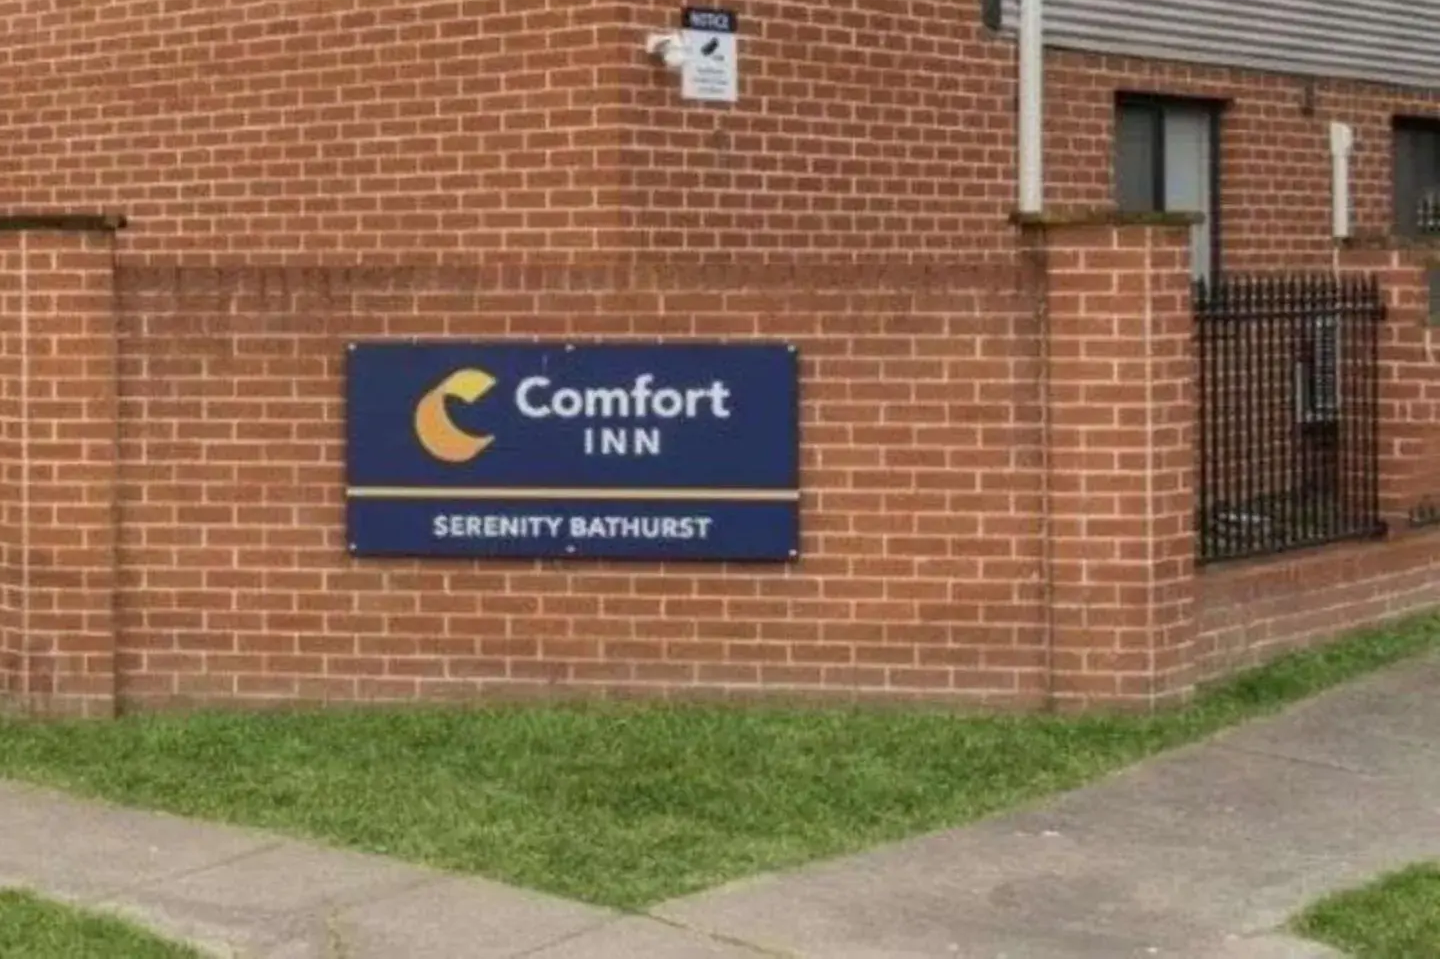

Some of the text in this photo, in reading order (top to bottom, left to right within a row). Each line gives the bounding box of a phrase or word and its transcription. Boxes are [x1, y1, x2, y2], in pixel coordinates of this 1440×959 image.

[514, 374, 732, 418] Comfort
[583, 427, 661, 456] INN
[433, 515, 713, 539] SERENITY BATHURST
